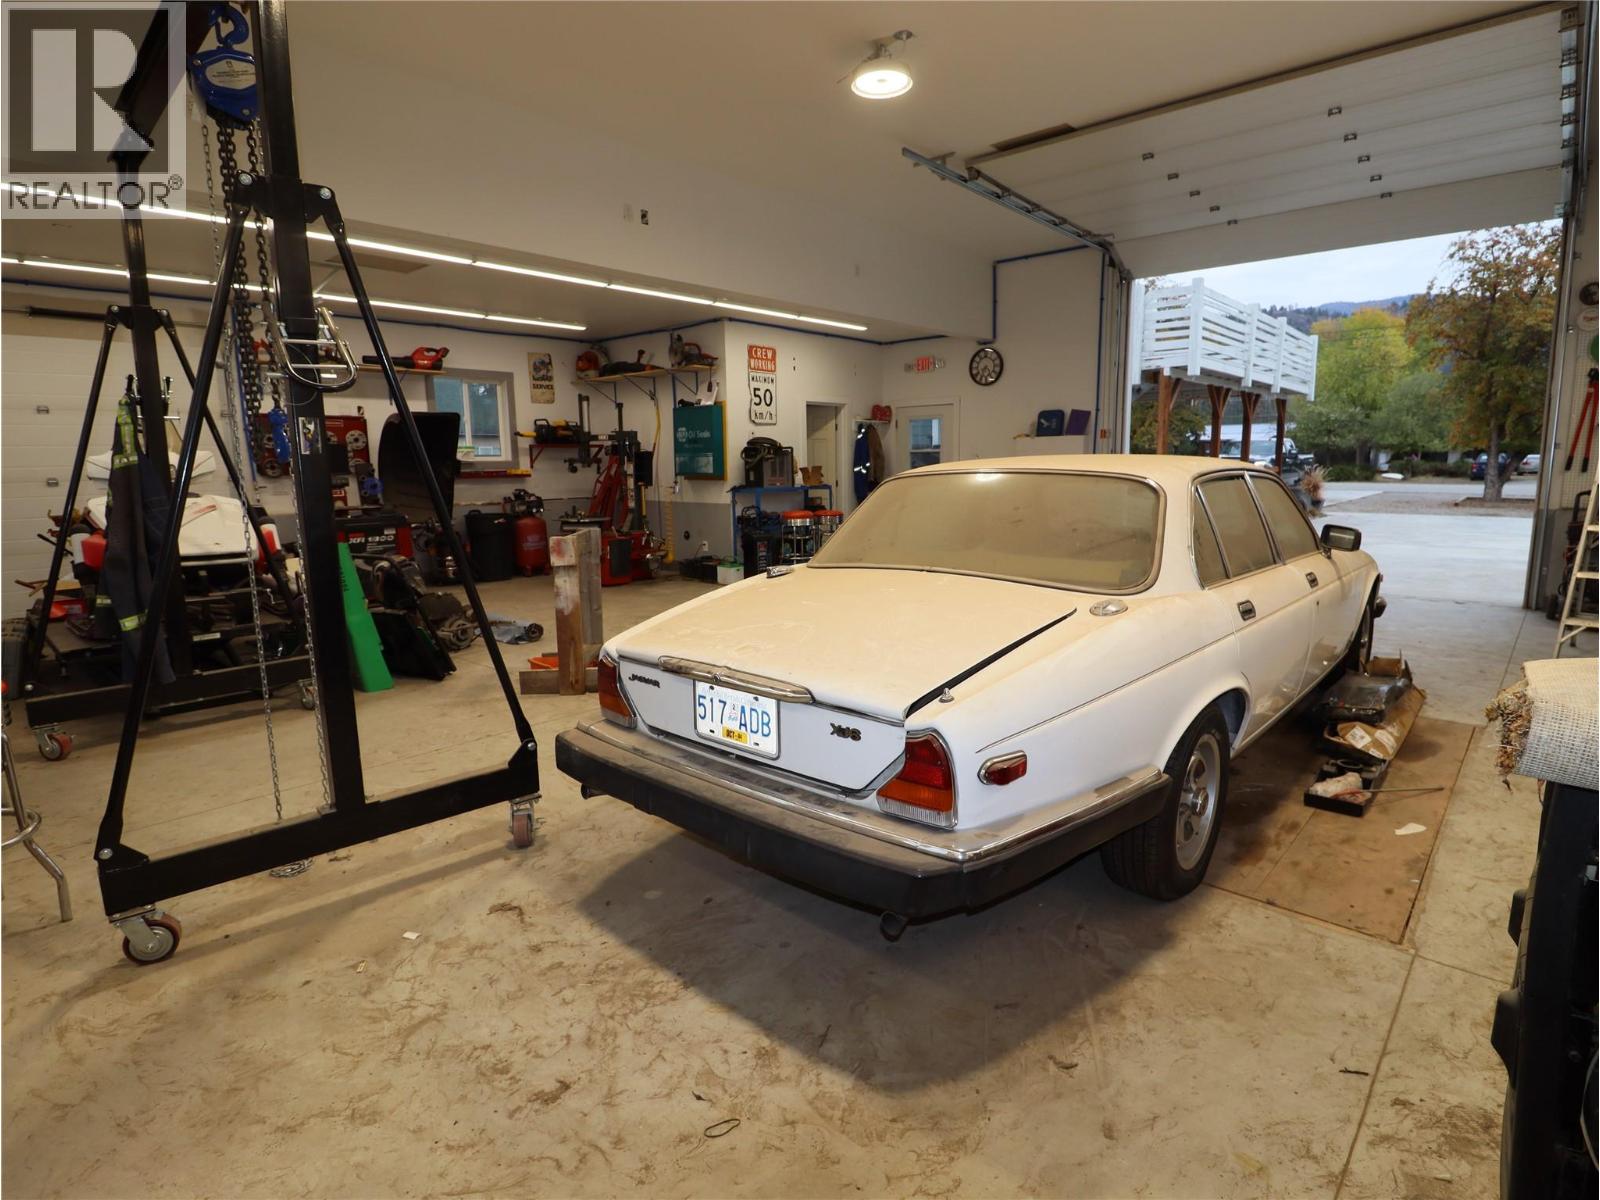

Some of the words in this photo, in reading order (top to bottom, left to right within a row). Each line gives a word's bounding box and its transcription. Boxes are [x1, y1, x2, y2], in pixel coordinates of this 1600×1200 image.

[752, 347, 773, 360] CREW
[750, 359, 775, 371] WORKING
[751, 375, 775, 384] MAXIMUM
[753, 387, 773, 407] 50
[754, 410, 773, 421] km/h
[698, 694, 727, 725] 517
[739, 704, 771, 737] ADB
[830, 722, 862, 742] XJ6
